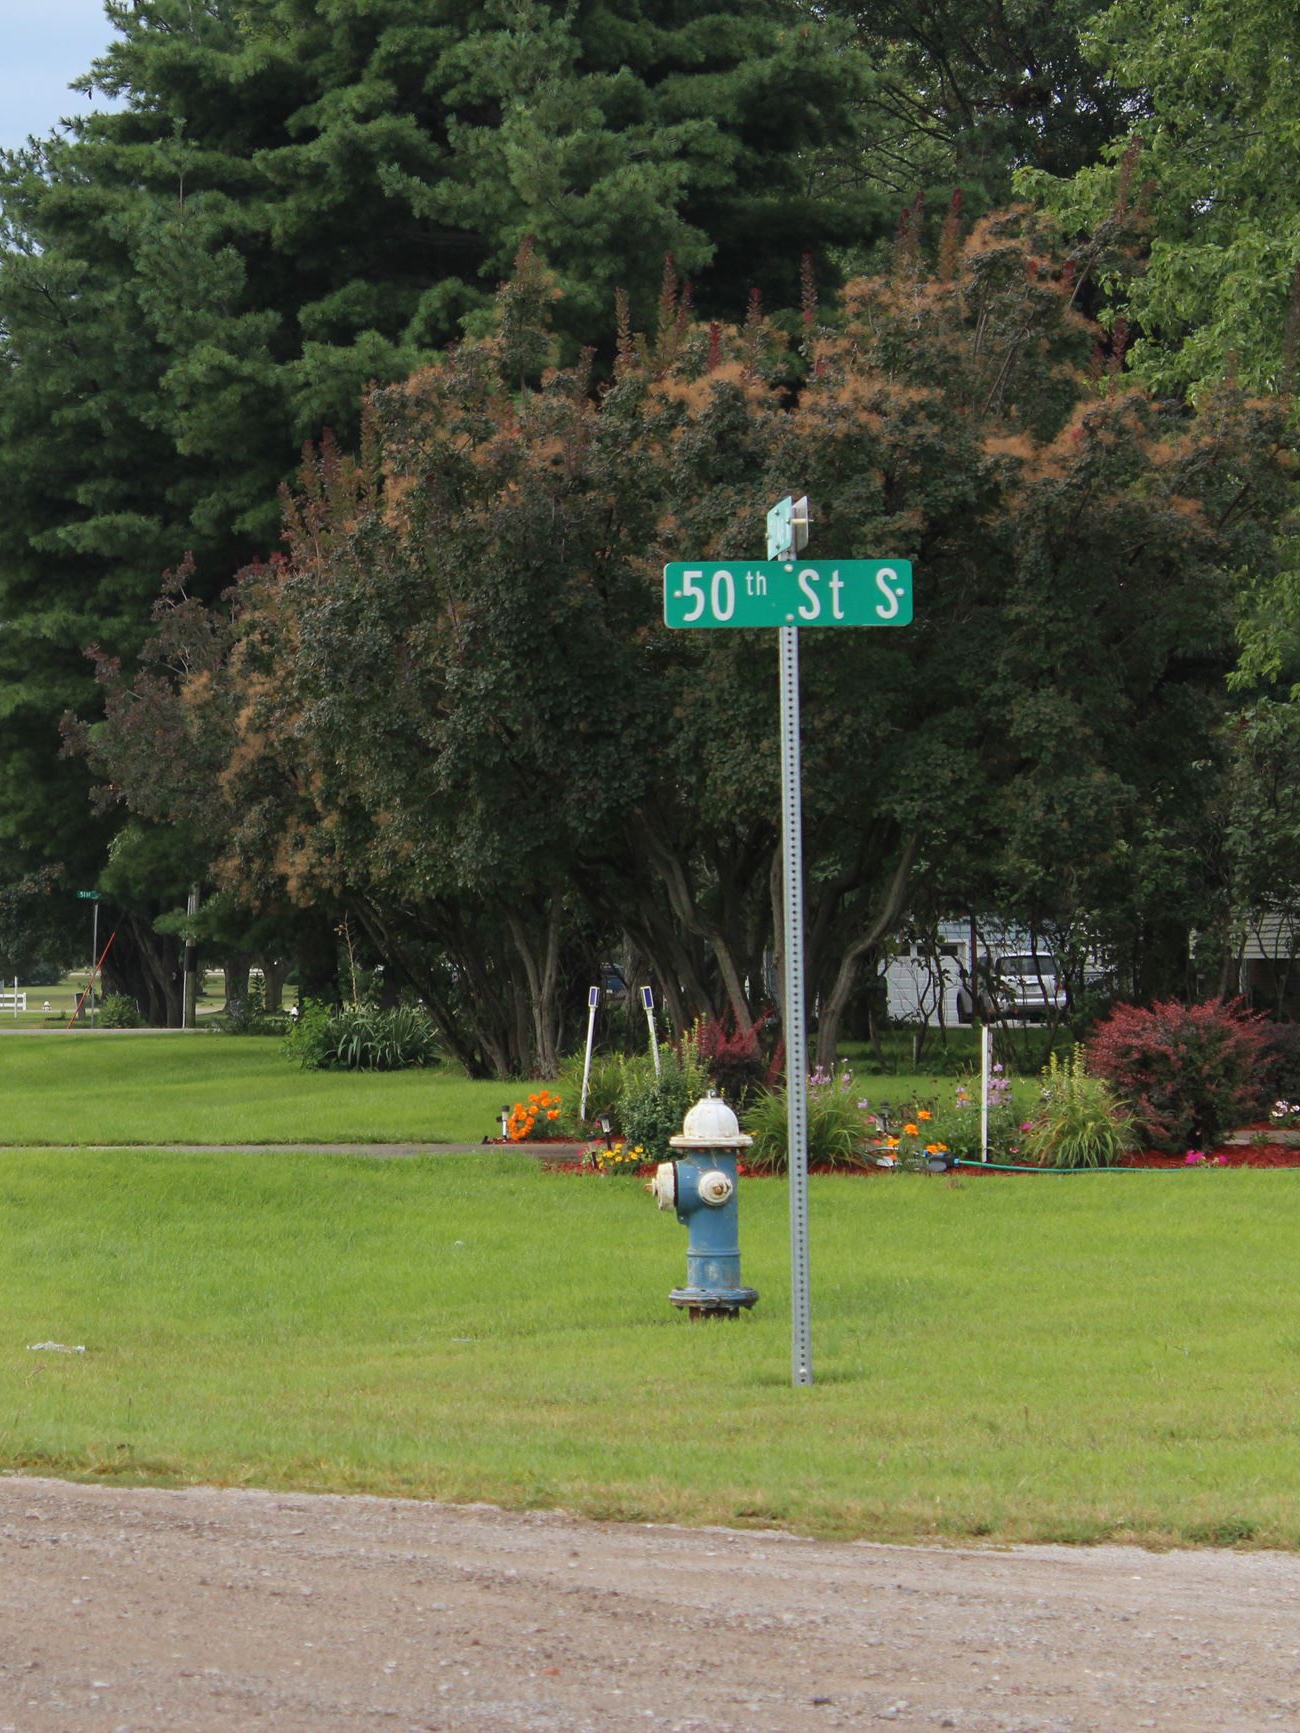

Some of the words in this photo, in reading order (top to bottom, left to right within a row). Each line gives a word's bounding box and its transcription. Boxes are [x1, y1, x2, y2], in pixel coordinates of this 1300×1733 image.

[682, 569, 767, 622] 50th
[798, 568, 845, 620] St
[875, 567, 899, 619] S
